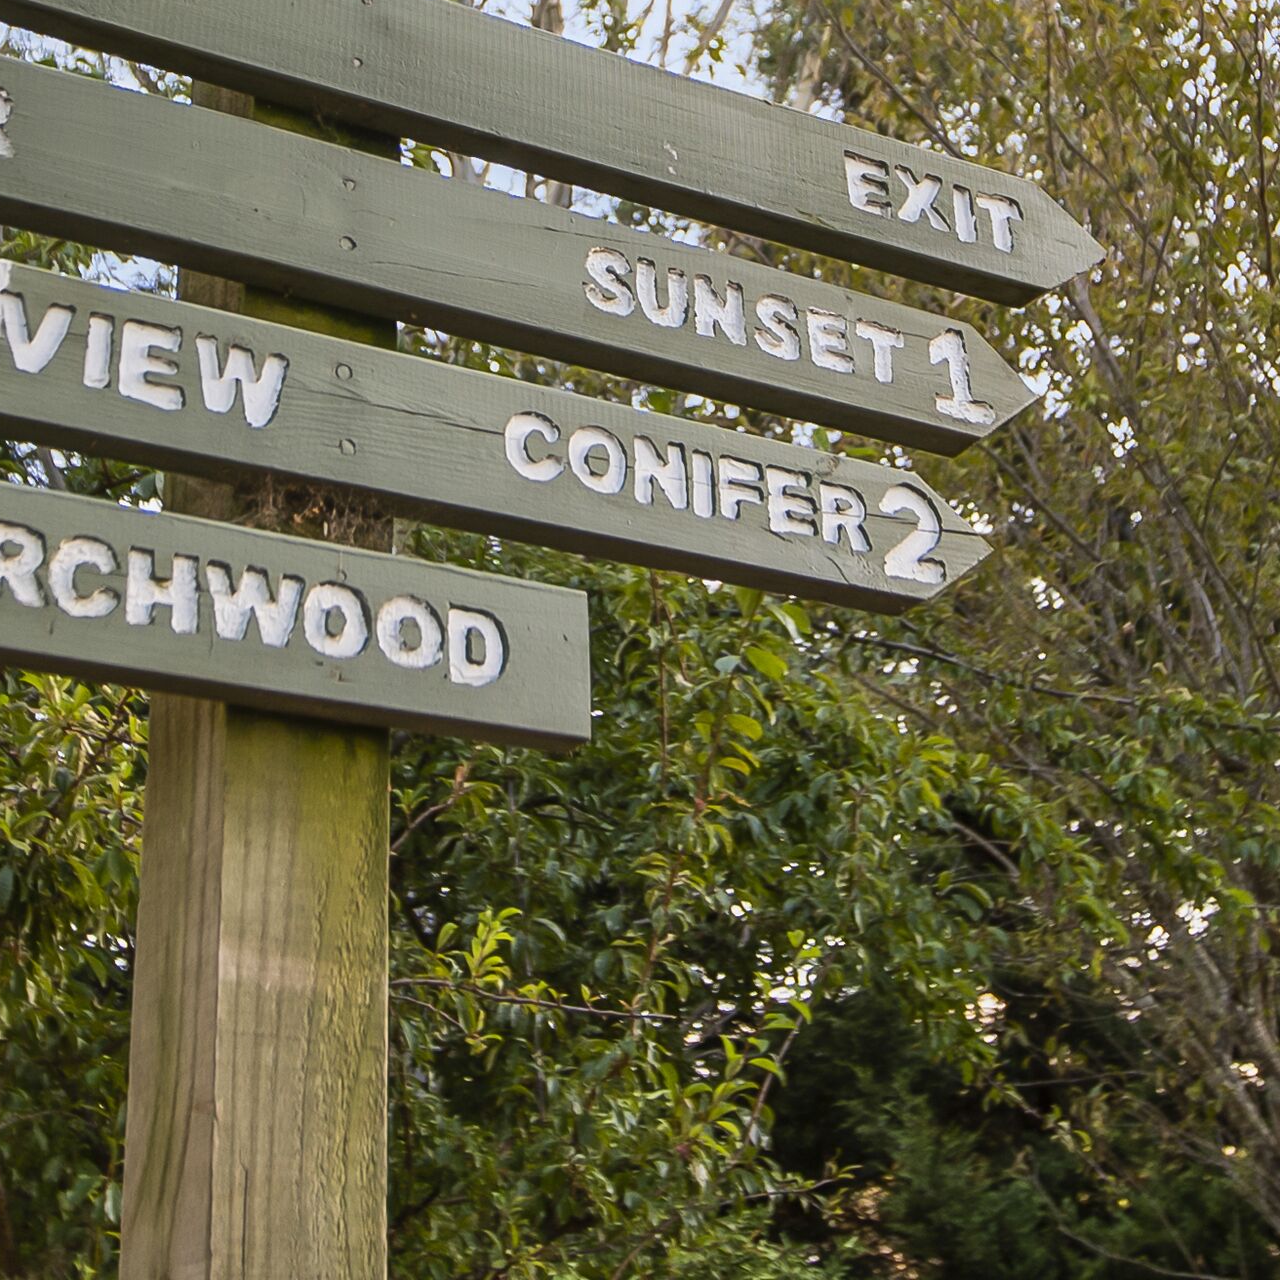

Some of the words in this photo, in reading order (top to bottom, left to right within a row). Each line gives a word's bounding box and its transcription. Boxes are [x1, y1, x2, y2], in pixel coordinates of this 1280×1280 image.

[845, 150, 1023, 253] EXIT
[582, 246, 905, 383] SUNSET
[929, 328, 996, 422] 1
[504, 411, 871, 552] CONIFER
[878, 482, 946, 583] 2
